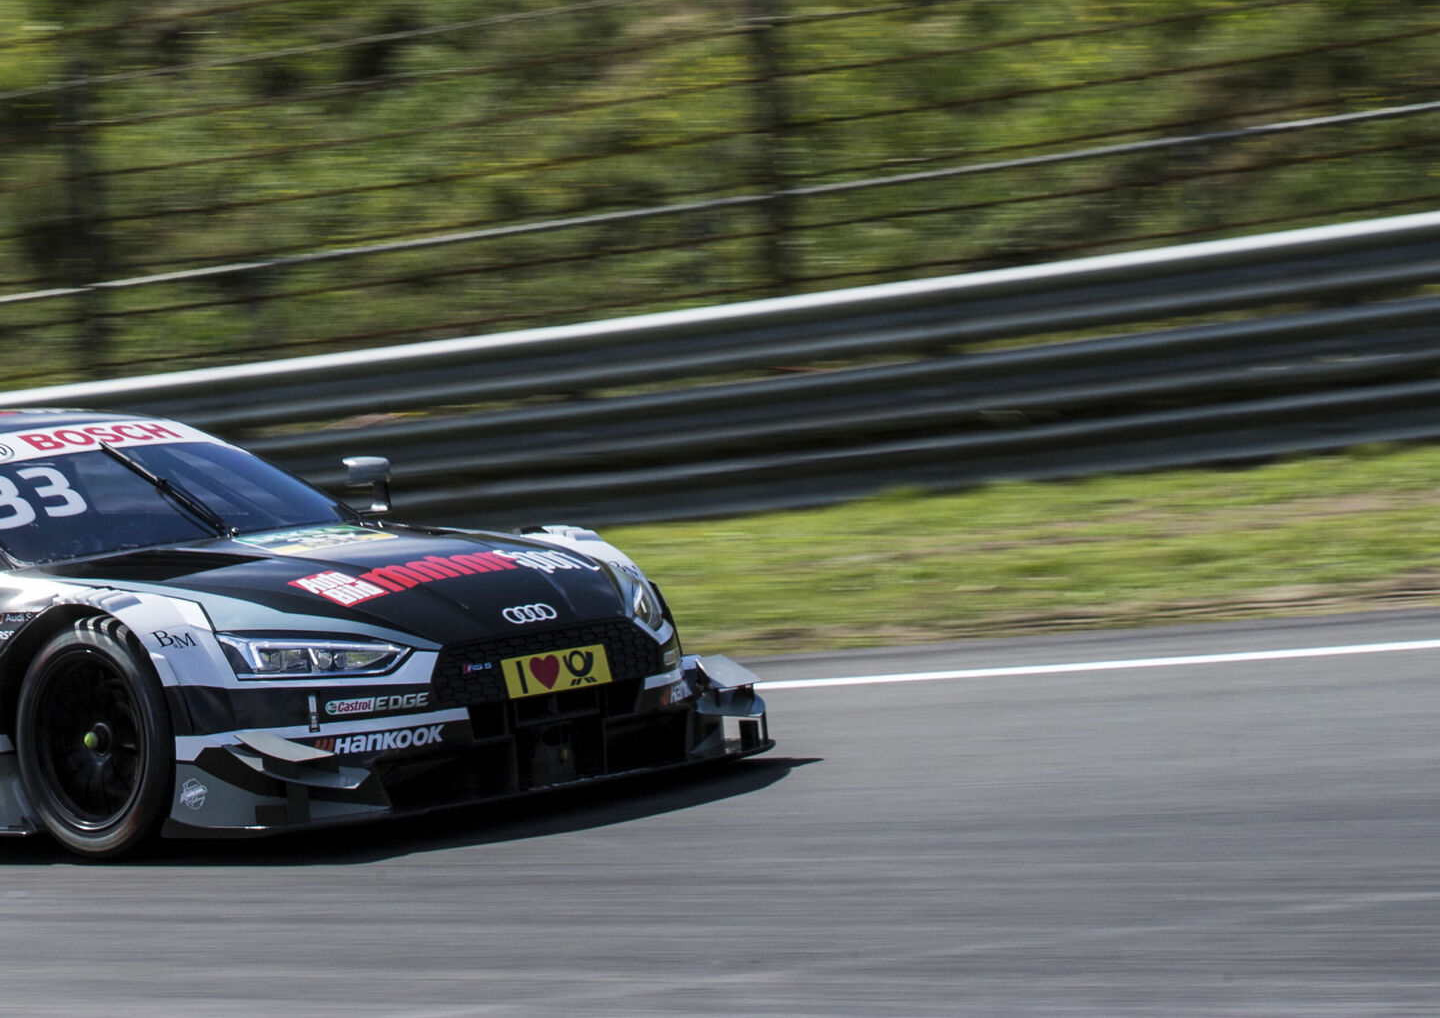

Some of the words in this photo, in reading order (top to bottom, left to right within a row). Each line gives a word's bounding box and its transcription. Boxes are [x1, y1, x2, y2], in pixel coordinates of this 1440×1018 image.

[17, 423, 184, 452] BOSCH
[296, 571, 357, 594] Auto
[323, 579, 385, 605] Bild
[4, 613, 25, 622] Audi
[337, 699, 372, 713] Castrol
[373, 692, 431, 711] EDGE
